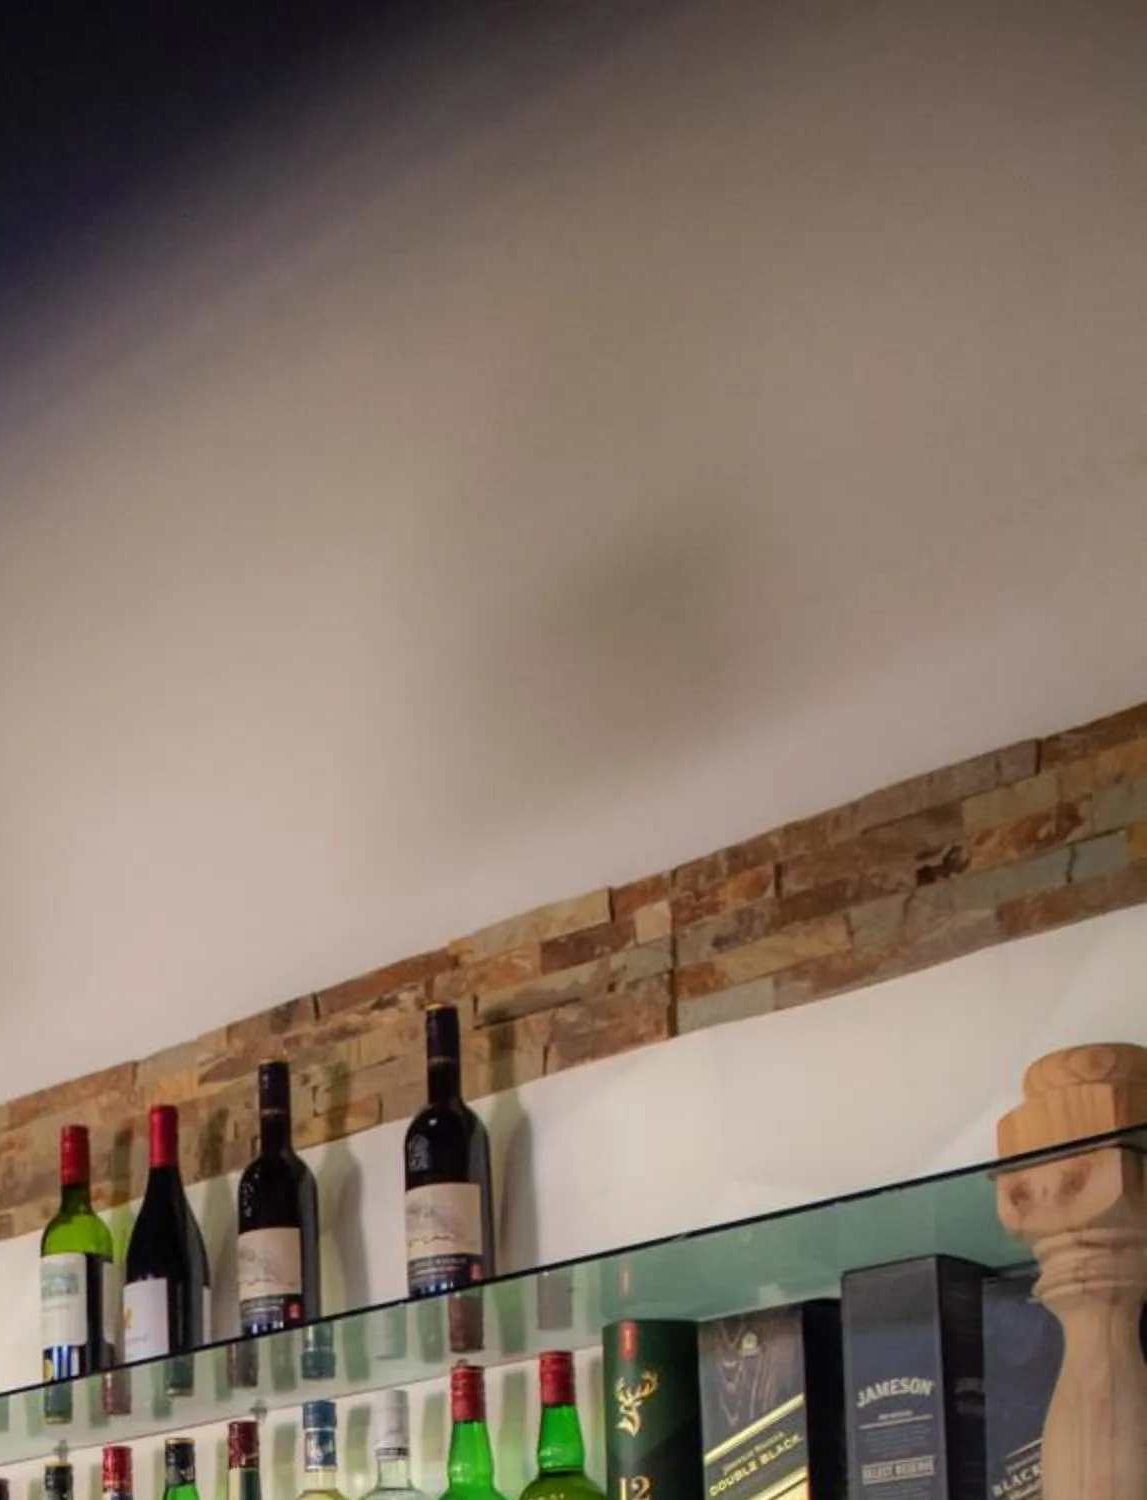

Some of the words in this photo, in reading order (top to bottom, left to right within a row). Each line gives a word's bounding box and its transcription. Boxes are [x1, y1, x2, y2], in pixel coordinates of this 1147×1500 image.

[857, 1377, 935, 1408] JAMESON
[709, 1459, 758, 1497] DOUBLE
[759, 1434, 803, 1465] BLACK
